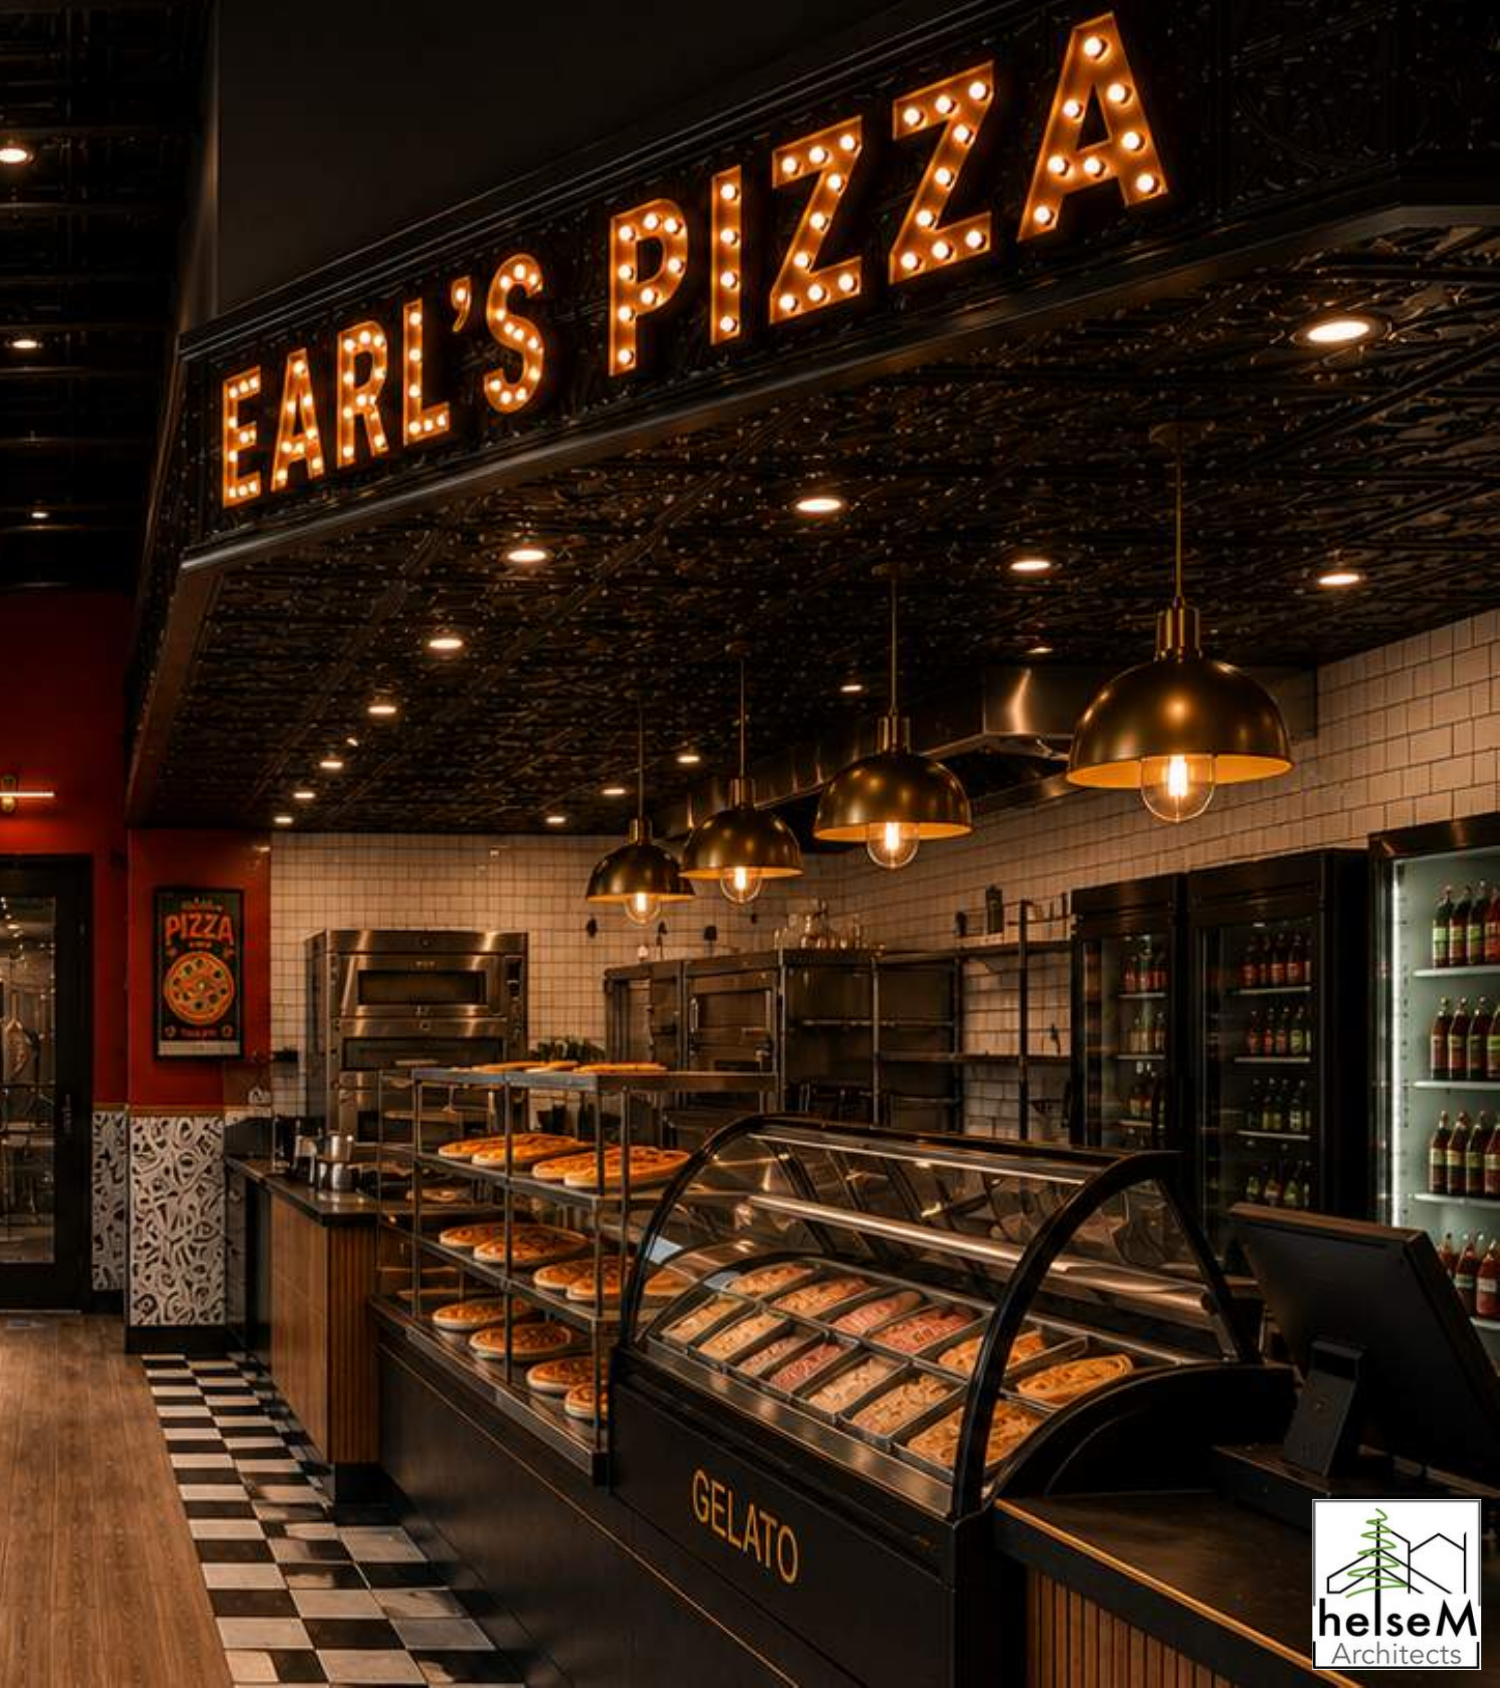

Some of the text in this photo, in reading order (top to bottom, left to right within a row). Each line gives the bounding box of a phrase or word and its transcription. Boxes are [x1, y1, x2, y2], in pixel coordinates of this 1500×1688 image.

[221, 12, 1169, 507] EARL'S PIZZA
[164, 911, 235, 947] PIZZA
[692, 1468, 799, 1585] GELATO
